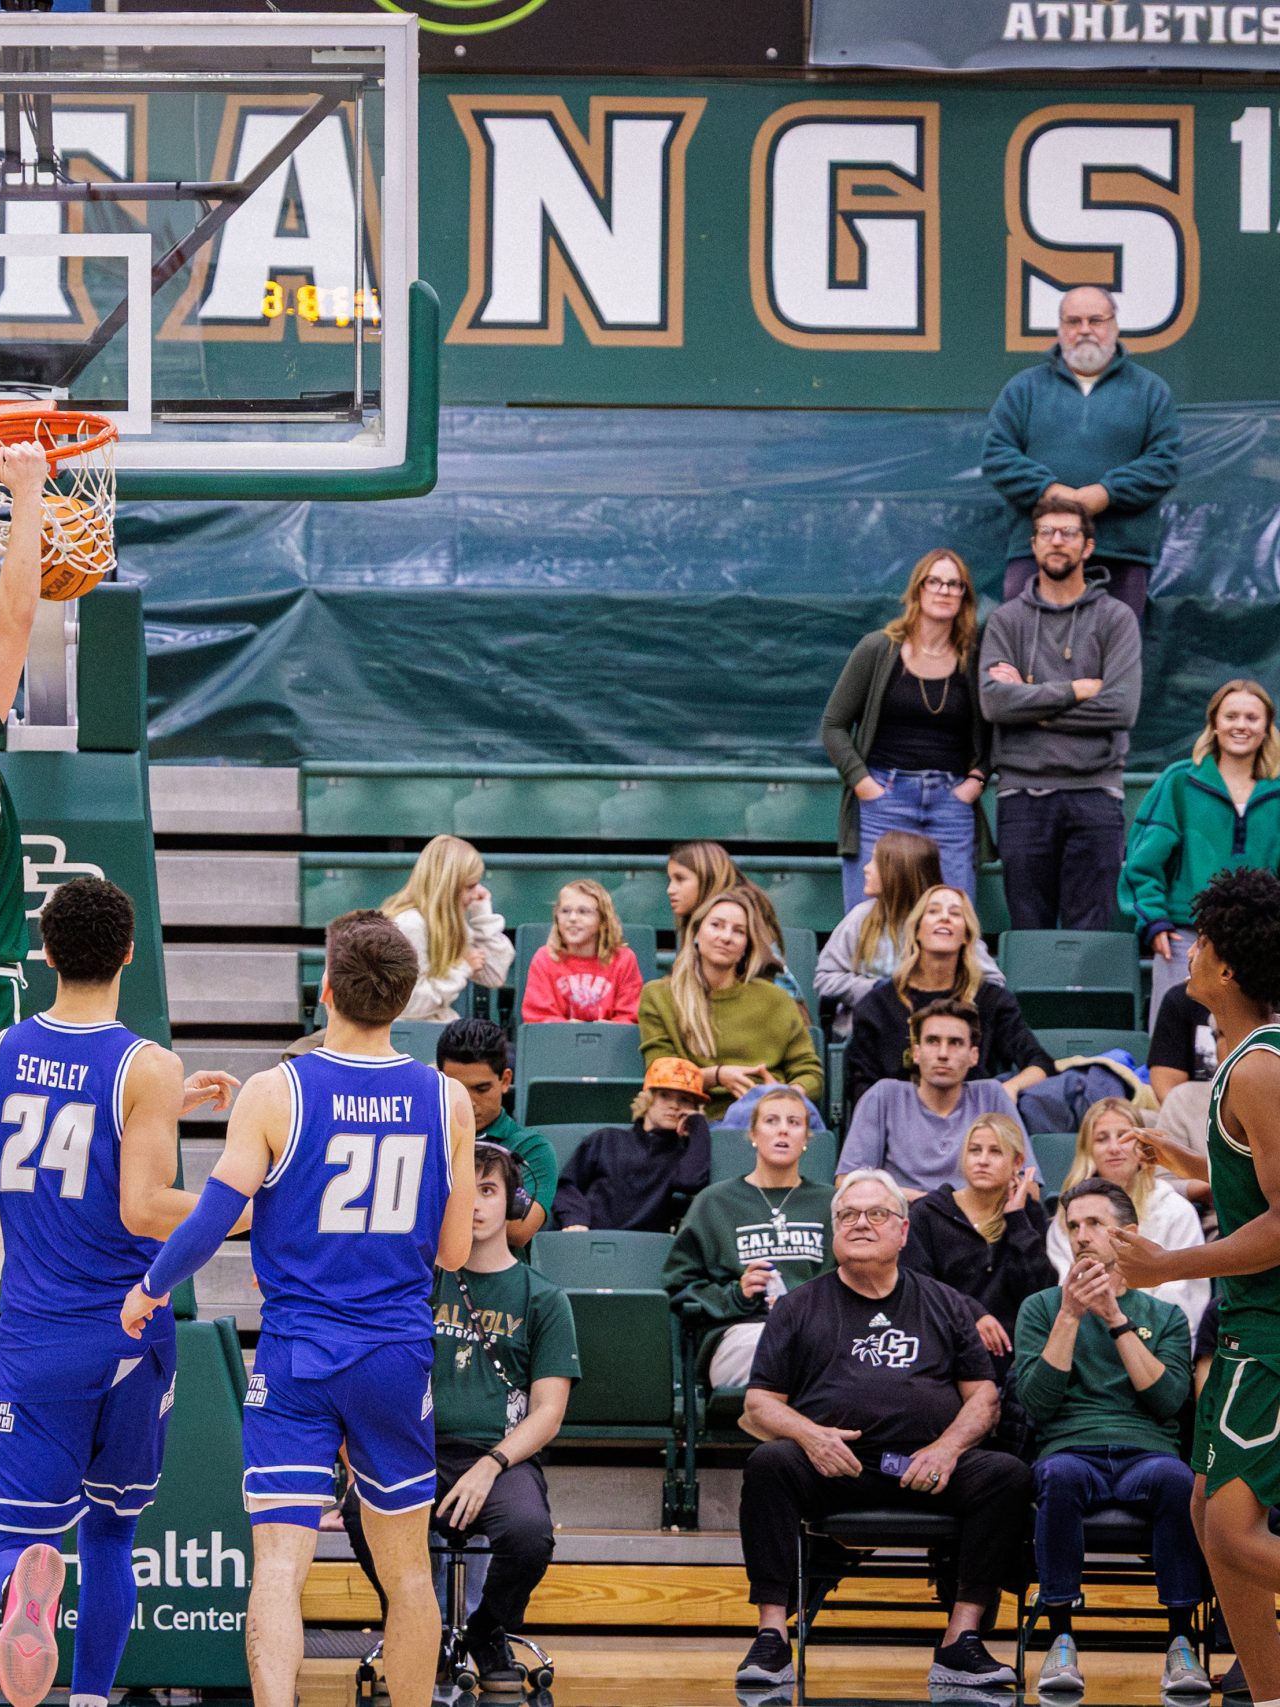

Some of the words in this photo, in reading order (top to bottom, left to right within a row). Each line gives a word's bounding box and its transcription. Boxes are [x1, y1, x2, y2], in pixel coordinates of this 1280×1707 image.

[1230, 106, 1280, 234] 1
[15, 1053, 90, 1092] SENSLEY
[332, 1094, 413, 1123] MAHANEY
[0, 1092, 97, 1200] 24
[317, 1132, 429, 1235] 20
[736, 1232, 775, 1251] CAL
[776, 1230, 824, 1249] POLY
[153, 1604, 247, 1631] Center
